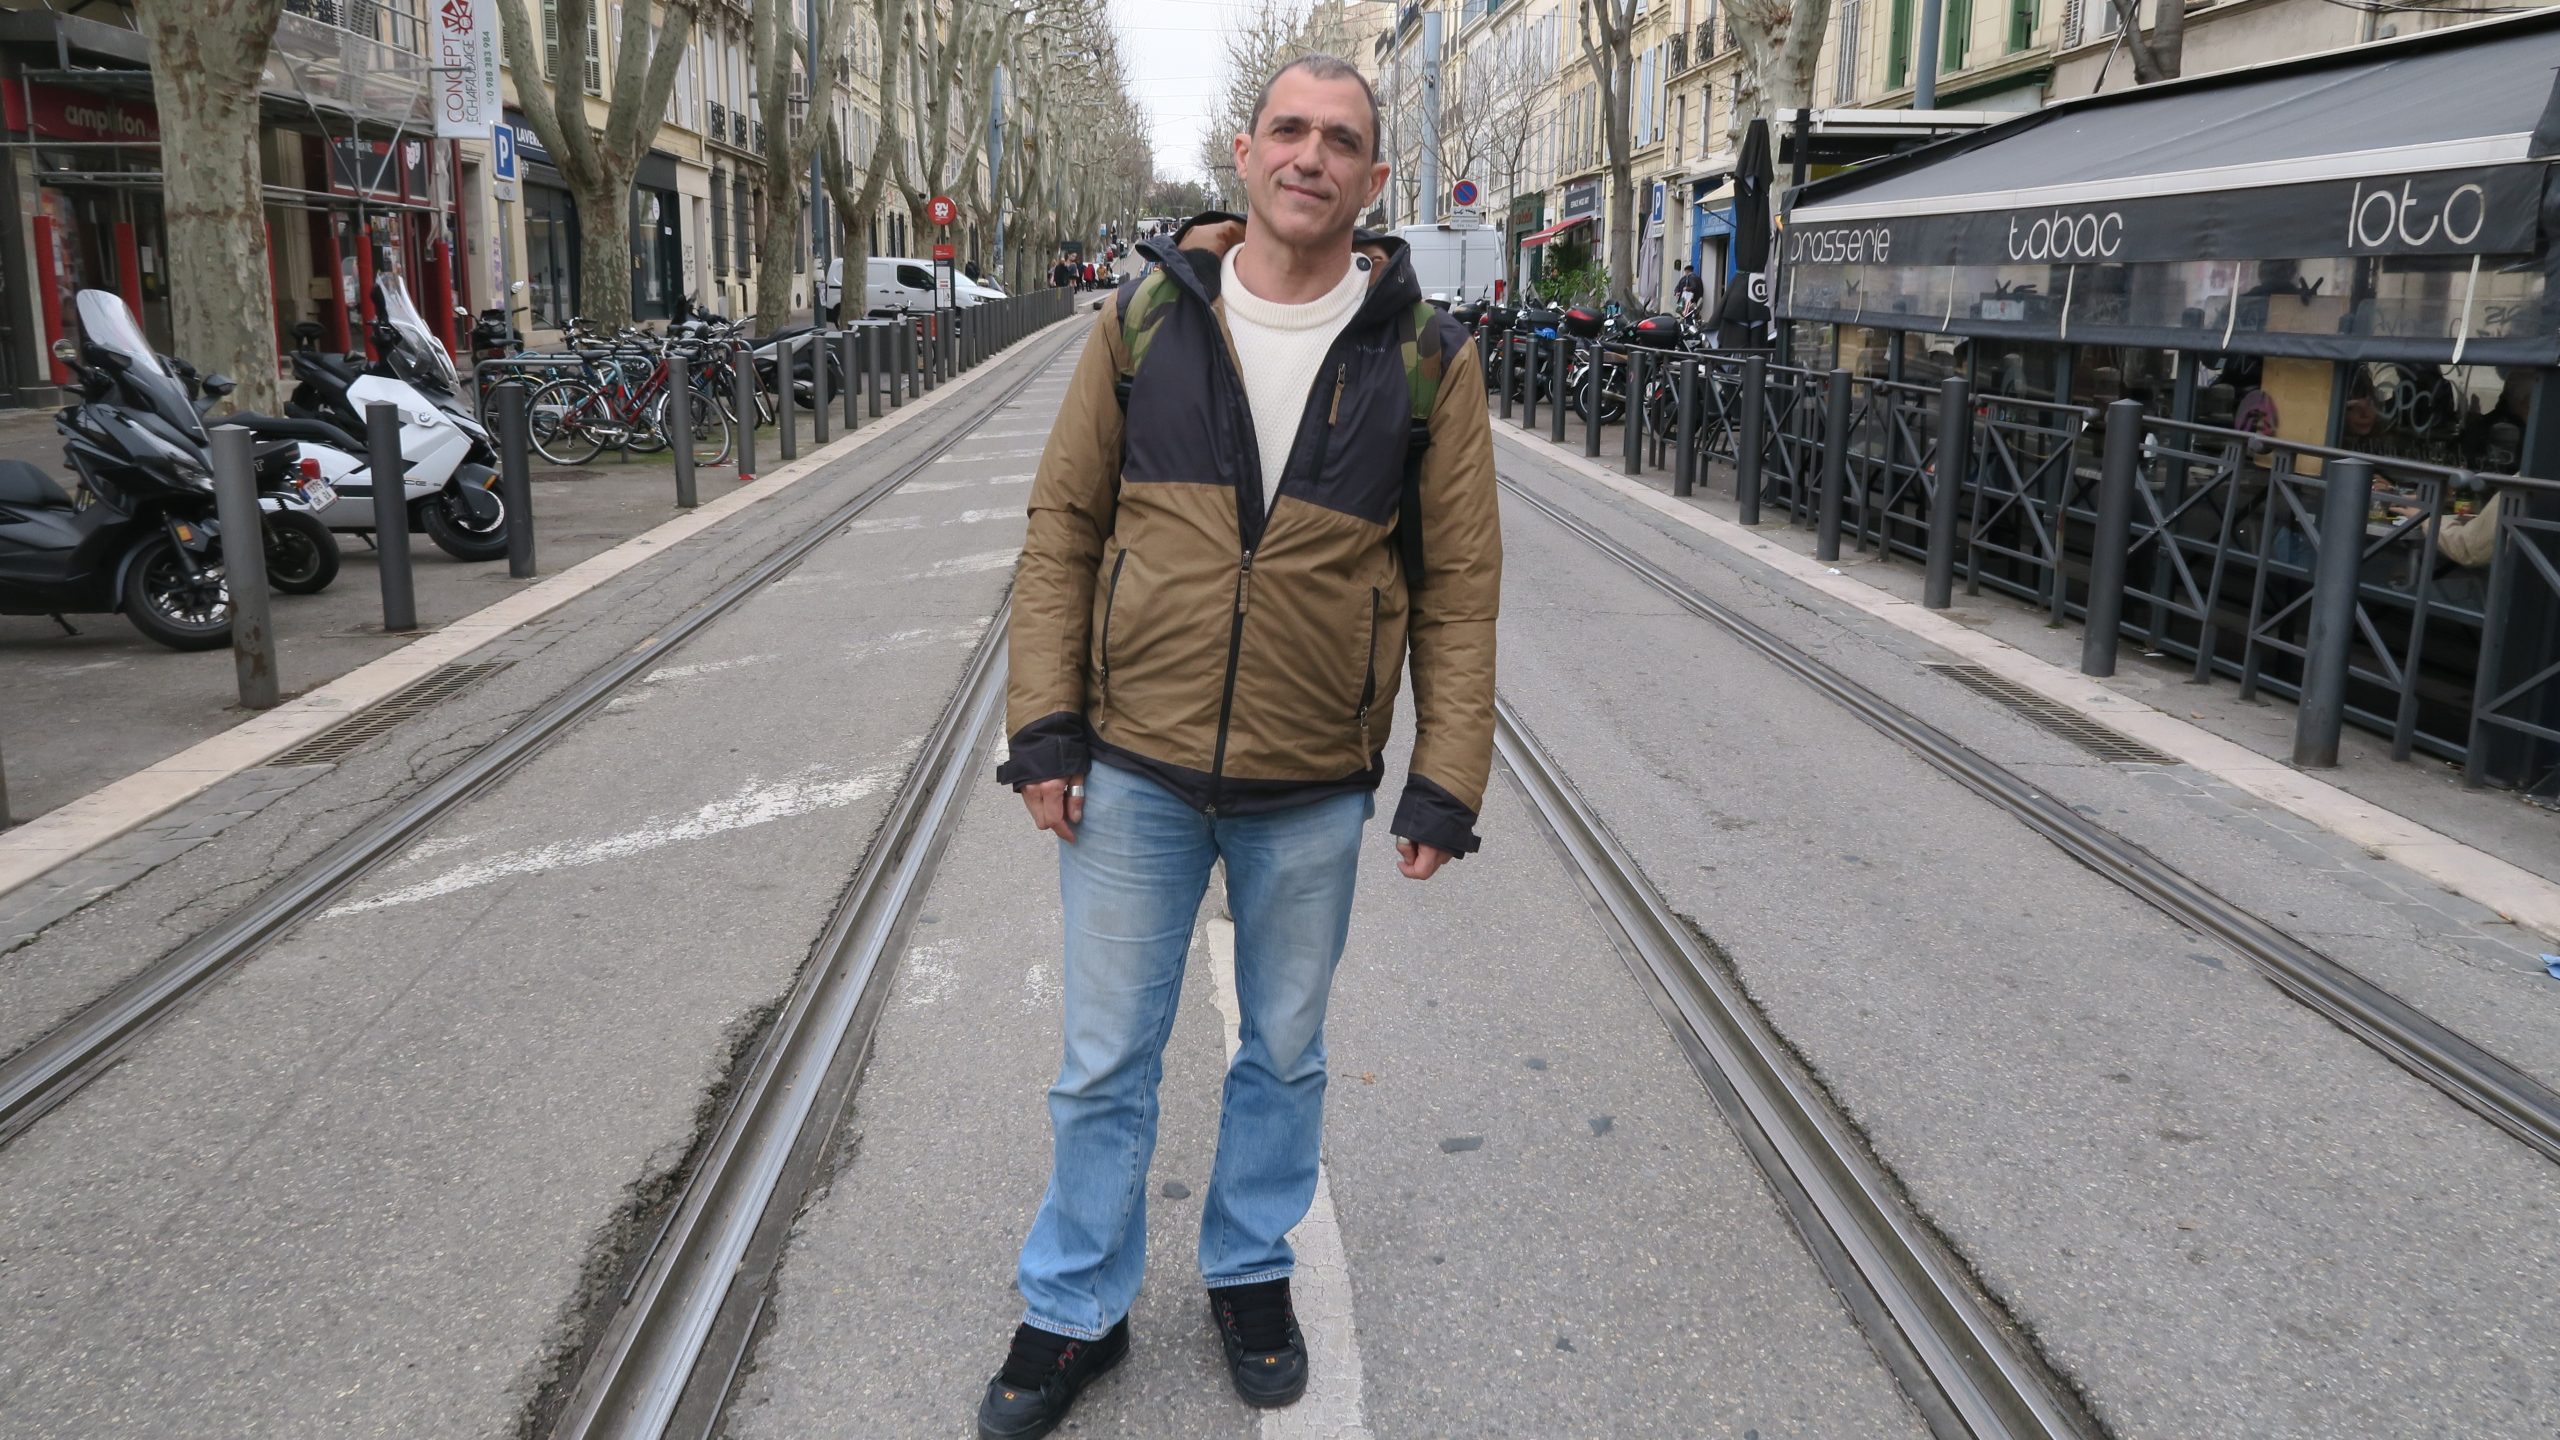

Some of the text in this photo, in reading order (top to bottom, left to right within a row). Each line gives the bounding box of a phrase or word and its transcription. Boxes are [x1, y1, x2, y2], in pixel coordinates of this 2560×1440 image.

[482, 30, 491, 48] 984
[442, 32, 465, 123] CONCEPT
[462, 40, 479, 123] ÉCHAFAUDAGE
[64, 104, 146, 138] amplfon
[498, 134, 509, 168] P
[1655, 191, 1661, 216] P
[2347, 179, 2486, 248] loto
[2008, 209, 2123, 261] tabac
